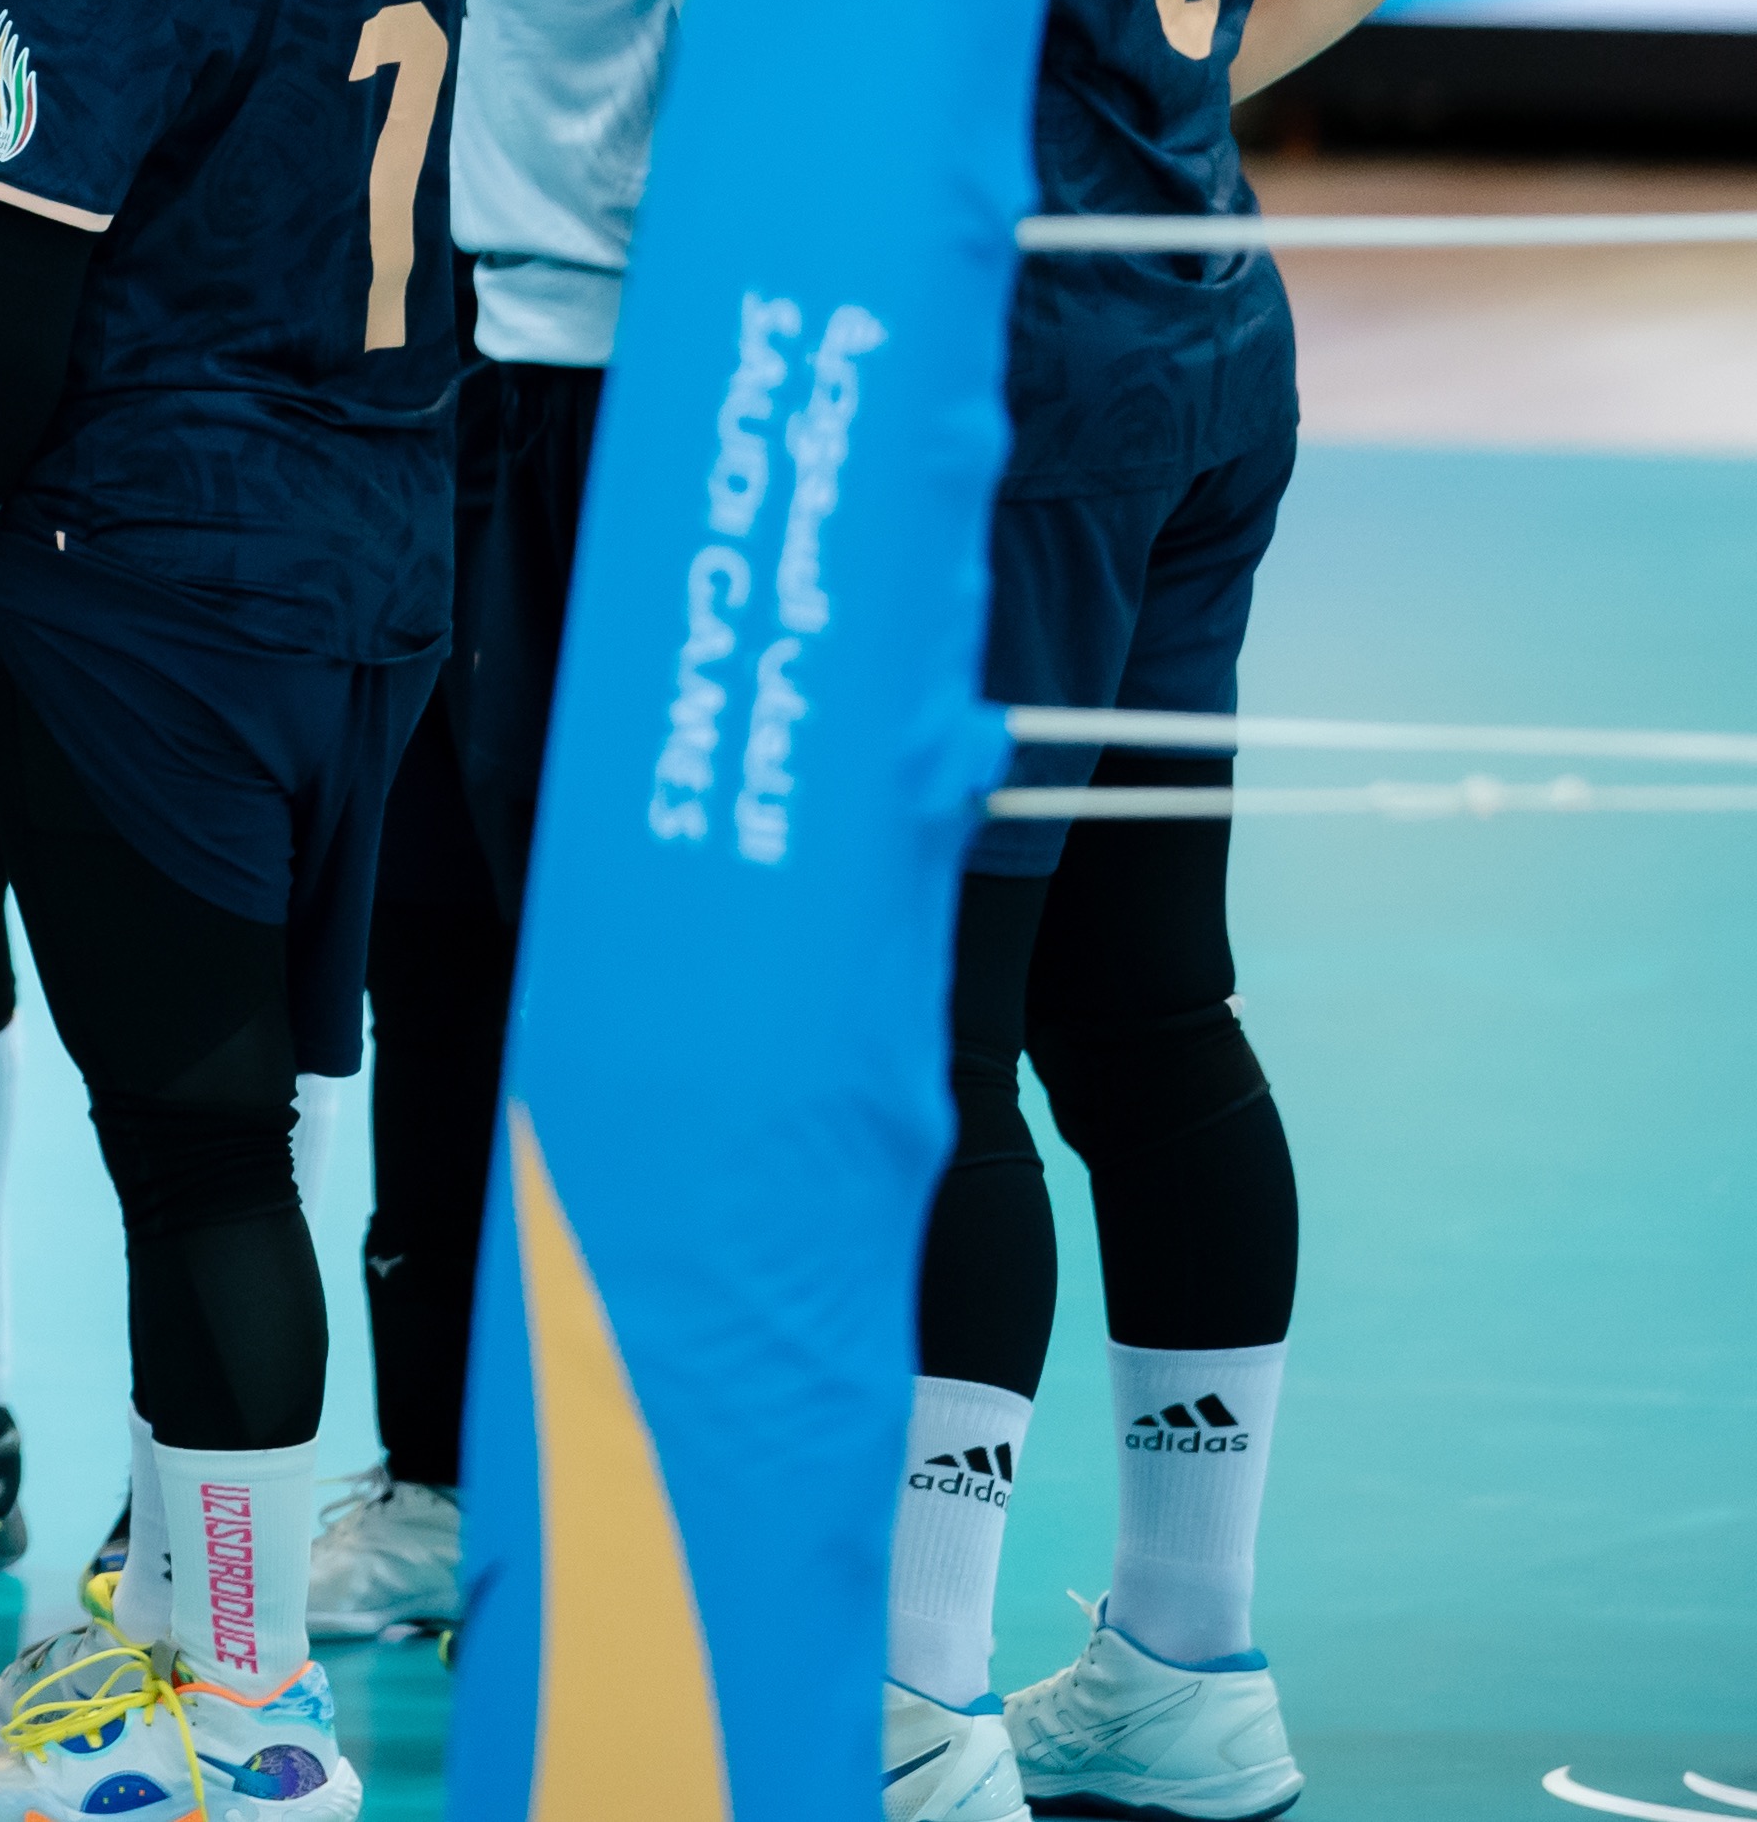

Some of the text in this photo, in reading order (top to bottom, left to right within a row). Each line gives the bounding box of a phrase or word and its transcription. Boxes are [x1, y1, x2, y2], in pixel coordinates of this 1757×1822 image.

[648, 290, 802, 841] SAUDI GAMES
[1125, 1430, 1249, 1453] adidas
[908, 1471, 1010, 1509] adida
